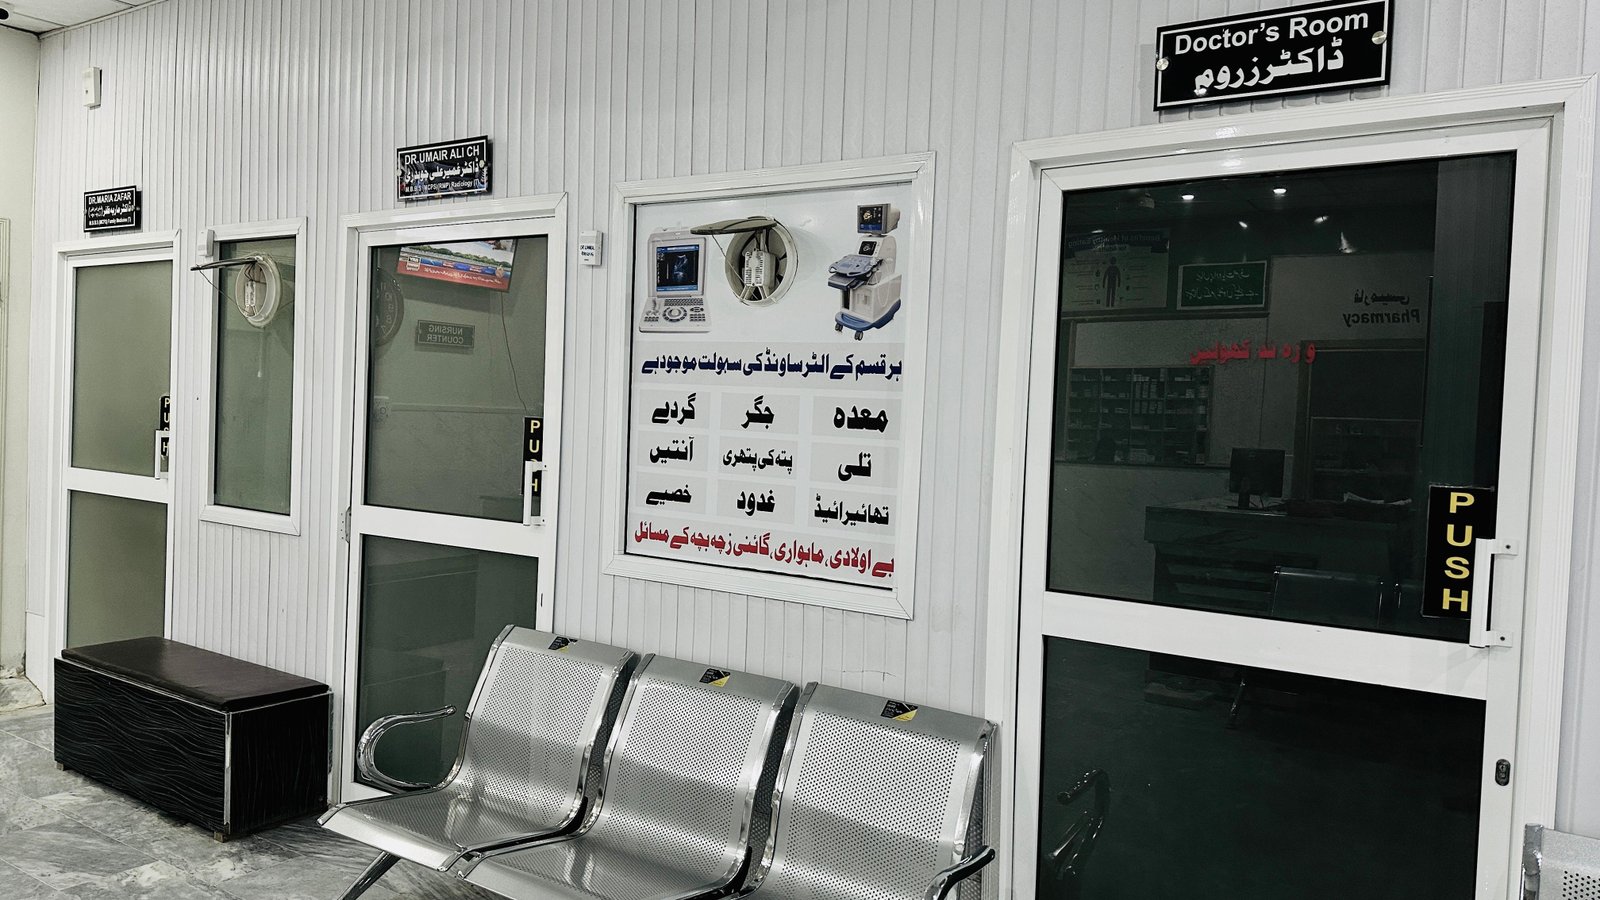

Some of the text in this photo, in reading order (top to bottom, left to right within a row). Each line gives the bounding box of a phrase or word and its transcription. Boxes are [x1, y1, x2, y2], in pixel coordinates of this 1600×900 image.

[1174, 12, 1369, 56] Doctor's Room
[404, 144, 480, 165] DR.UMAIR ALI CH
[114, 192, 131, 201] ZAFAR
[698, 352, 741, 376] سہولت
[743, 352, 763, 376] کی
[829, 353, 855, 380] کے
[855, 353, 886, 381] قسم
[652, 392, 697, 425] گردے
[741, 395, 775, 429] جگر
[833, 405, 889, 433] معدہ
[649, 436, 695, 464] آنتیں
[722, 447, 793, 475] پتہ کی پتھری
[838, 452, 872, 482] تلی
[646, 484, 692, 506] خصیے
[736, 489, 776, 517] غدود
[635, 521, 670, 543] مسائل
[669, 526, 690, 550] کے
[690, 532, 710, 552] بچہ
[710, 533, 733, 555] زچہ
[733, 532, 771, 556] گائنی
[1442, 491, 1475, 612] PUSH
[871, 558, 894, 578] بے
